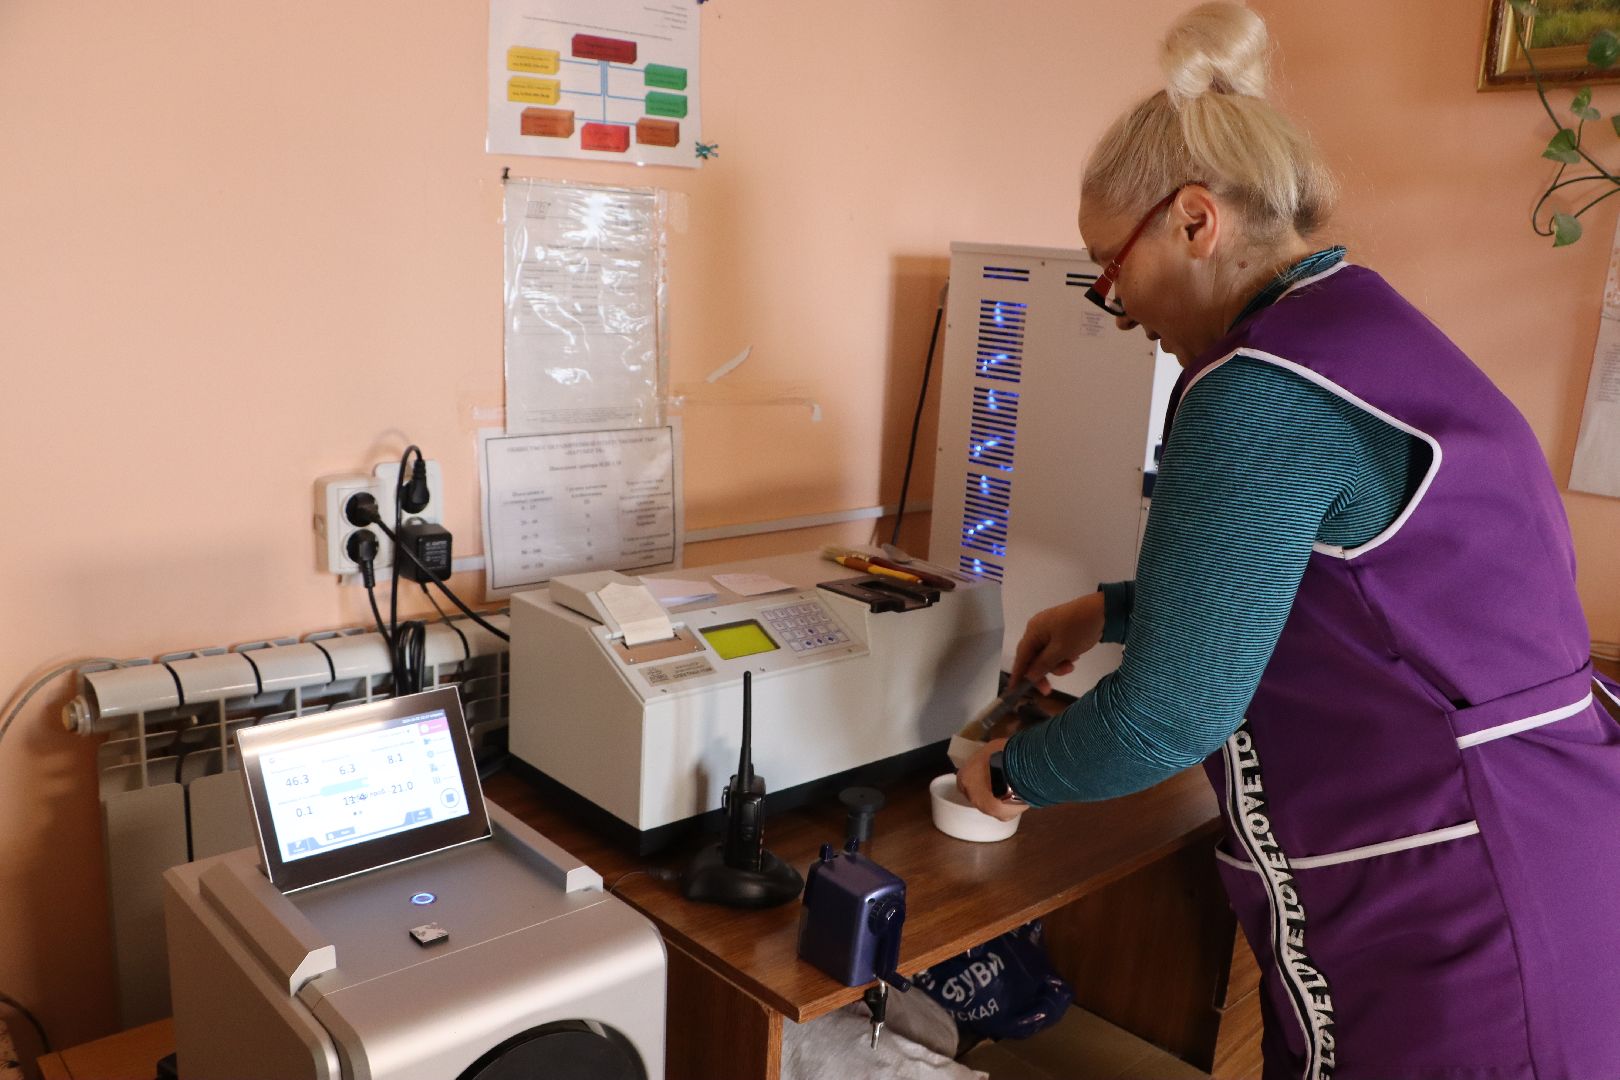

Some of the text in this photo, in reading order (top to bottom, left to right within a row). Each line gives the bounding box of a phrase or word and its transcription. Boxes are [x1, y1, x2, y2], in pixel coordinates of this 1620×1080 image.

[285, 774, 310, 787] 46.3
[296, 806, 313, 817] 0.1
[1242, 773, 1279, 849] LOVE
[1264, 851, 1306, 922] LOVE
